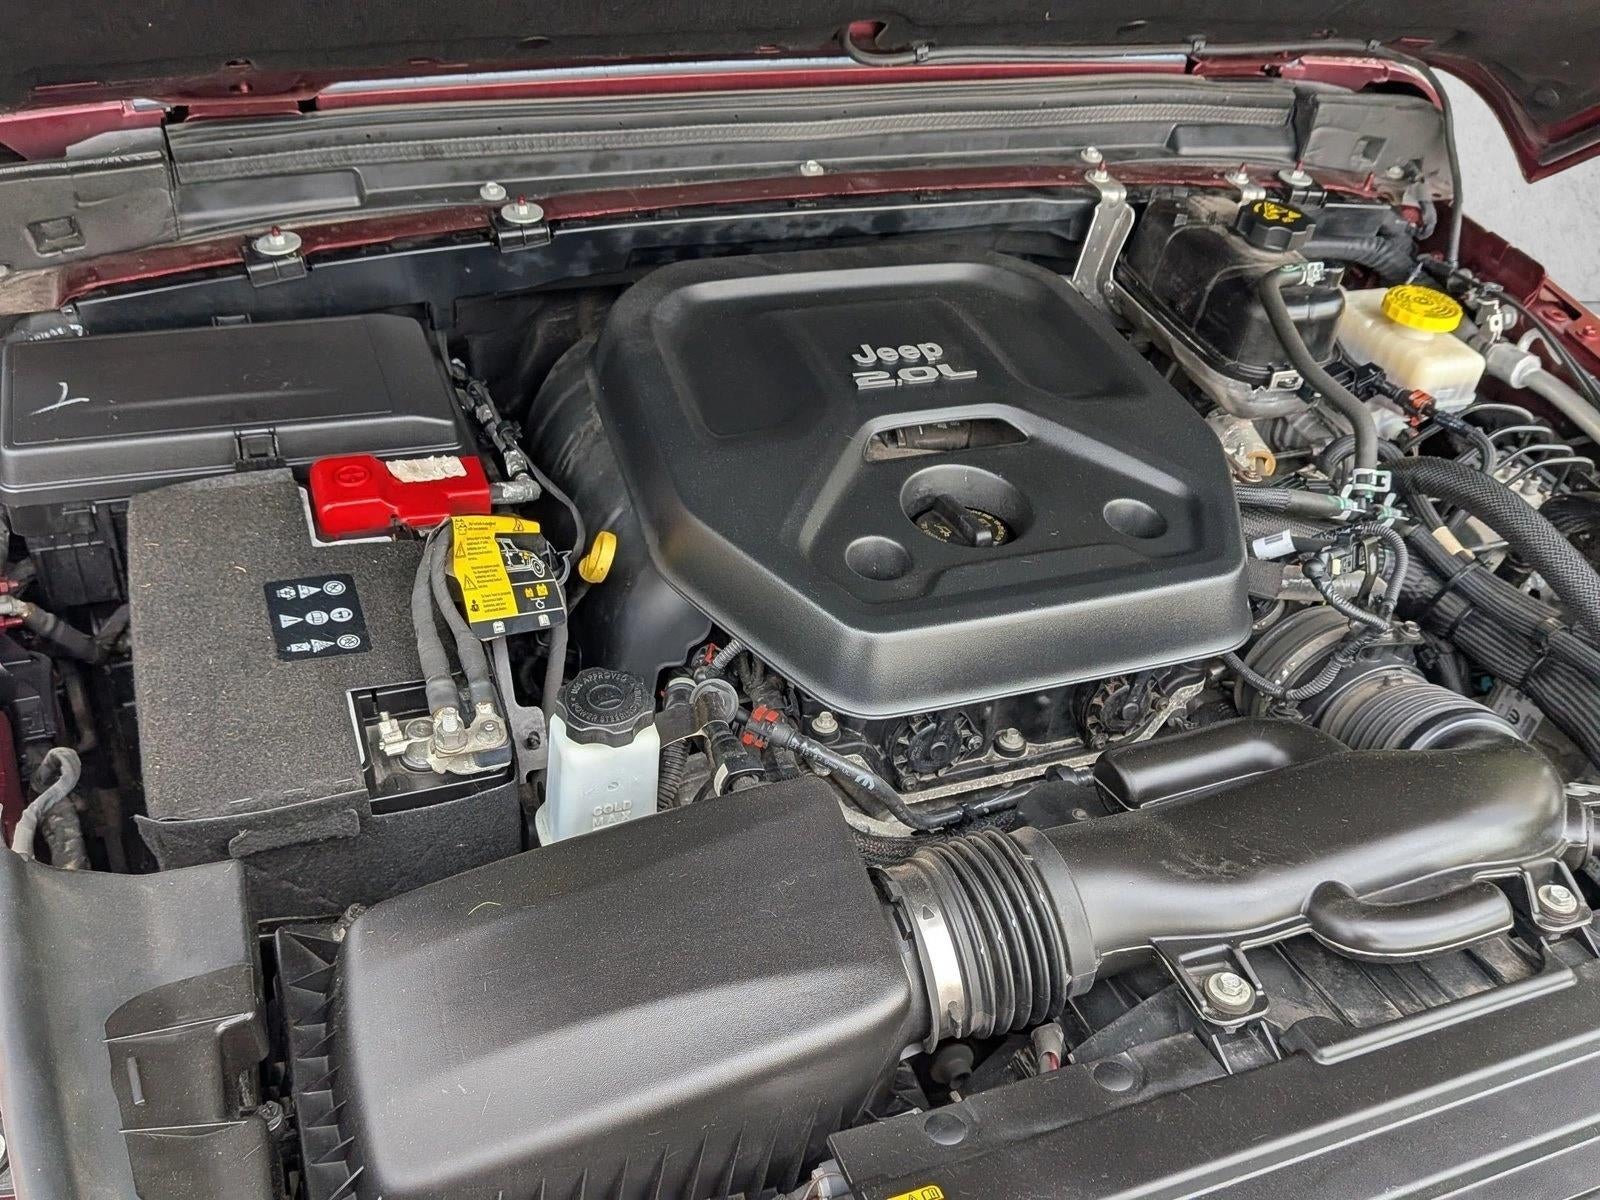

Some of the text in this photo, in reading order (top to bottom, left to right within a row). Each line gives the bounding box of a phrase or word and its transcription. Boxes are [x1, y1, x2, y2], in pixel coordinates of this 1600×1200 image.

[852, 342, 943, 365] Jeep
[852, 363, 978, 390] 2.0L
[593, 800, 632, 817] COLD
